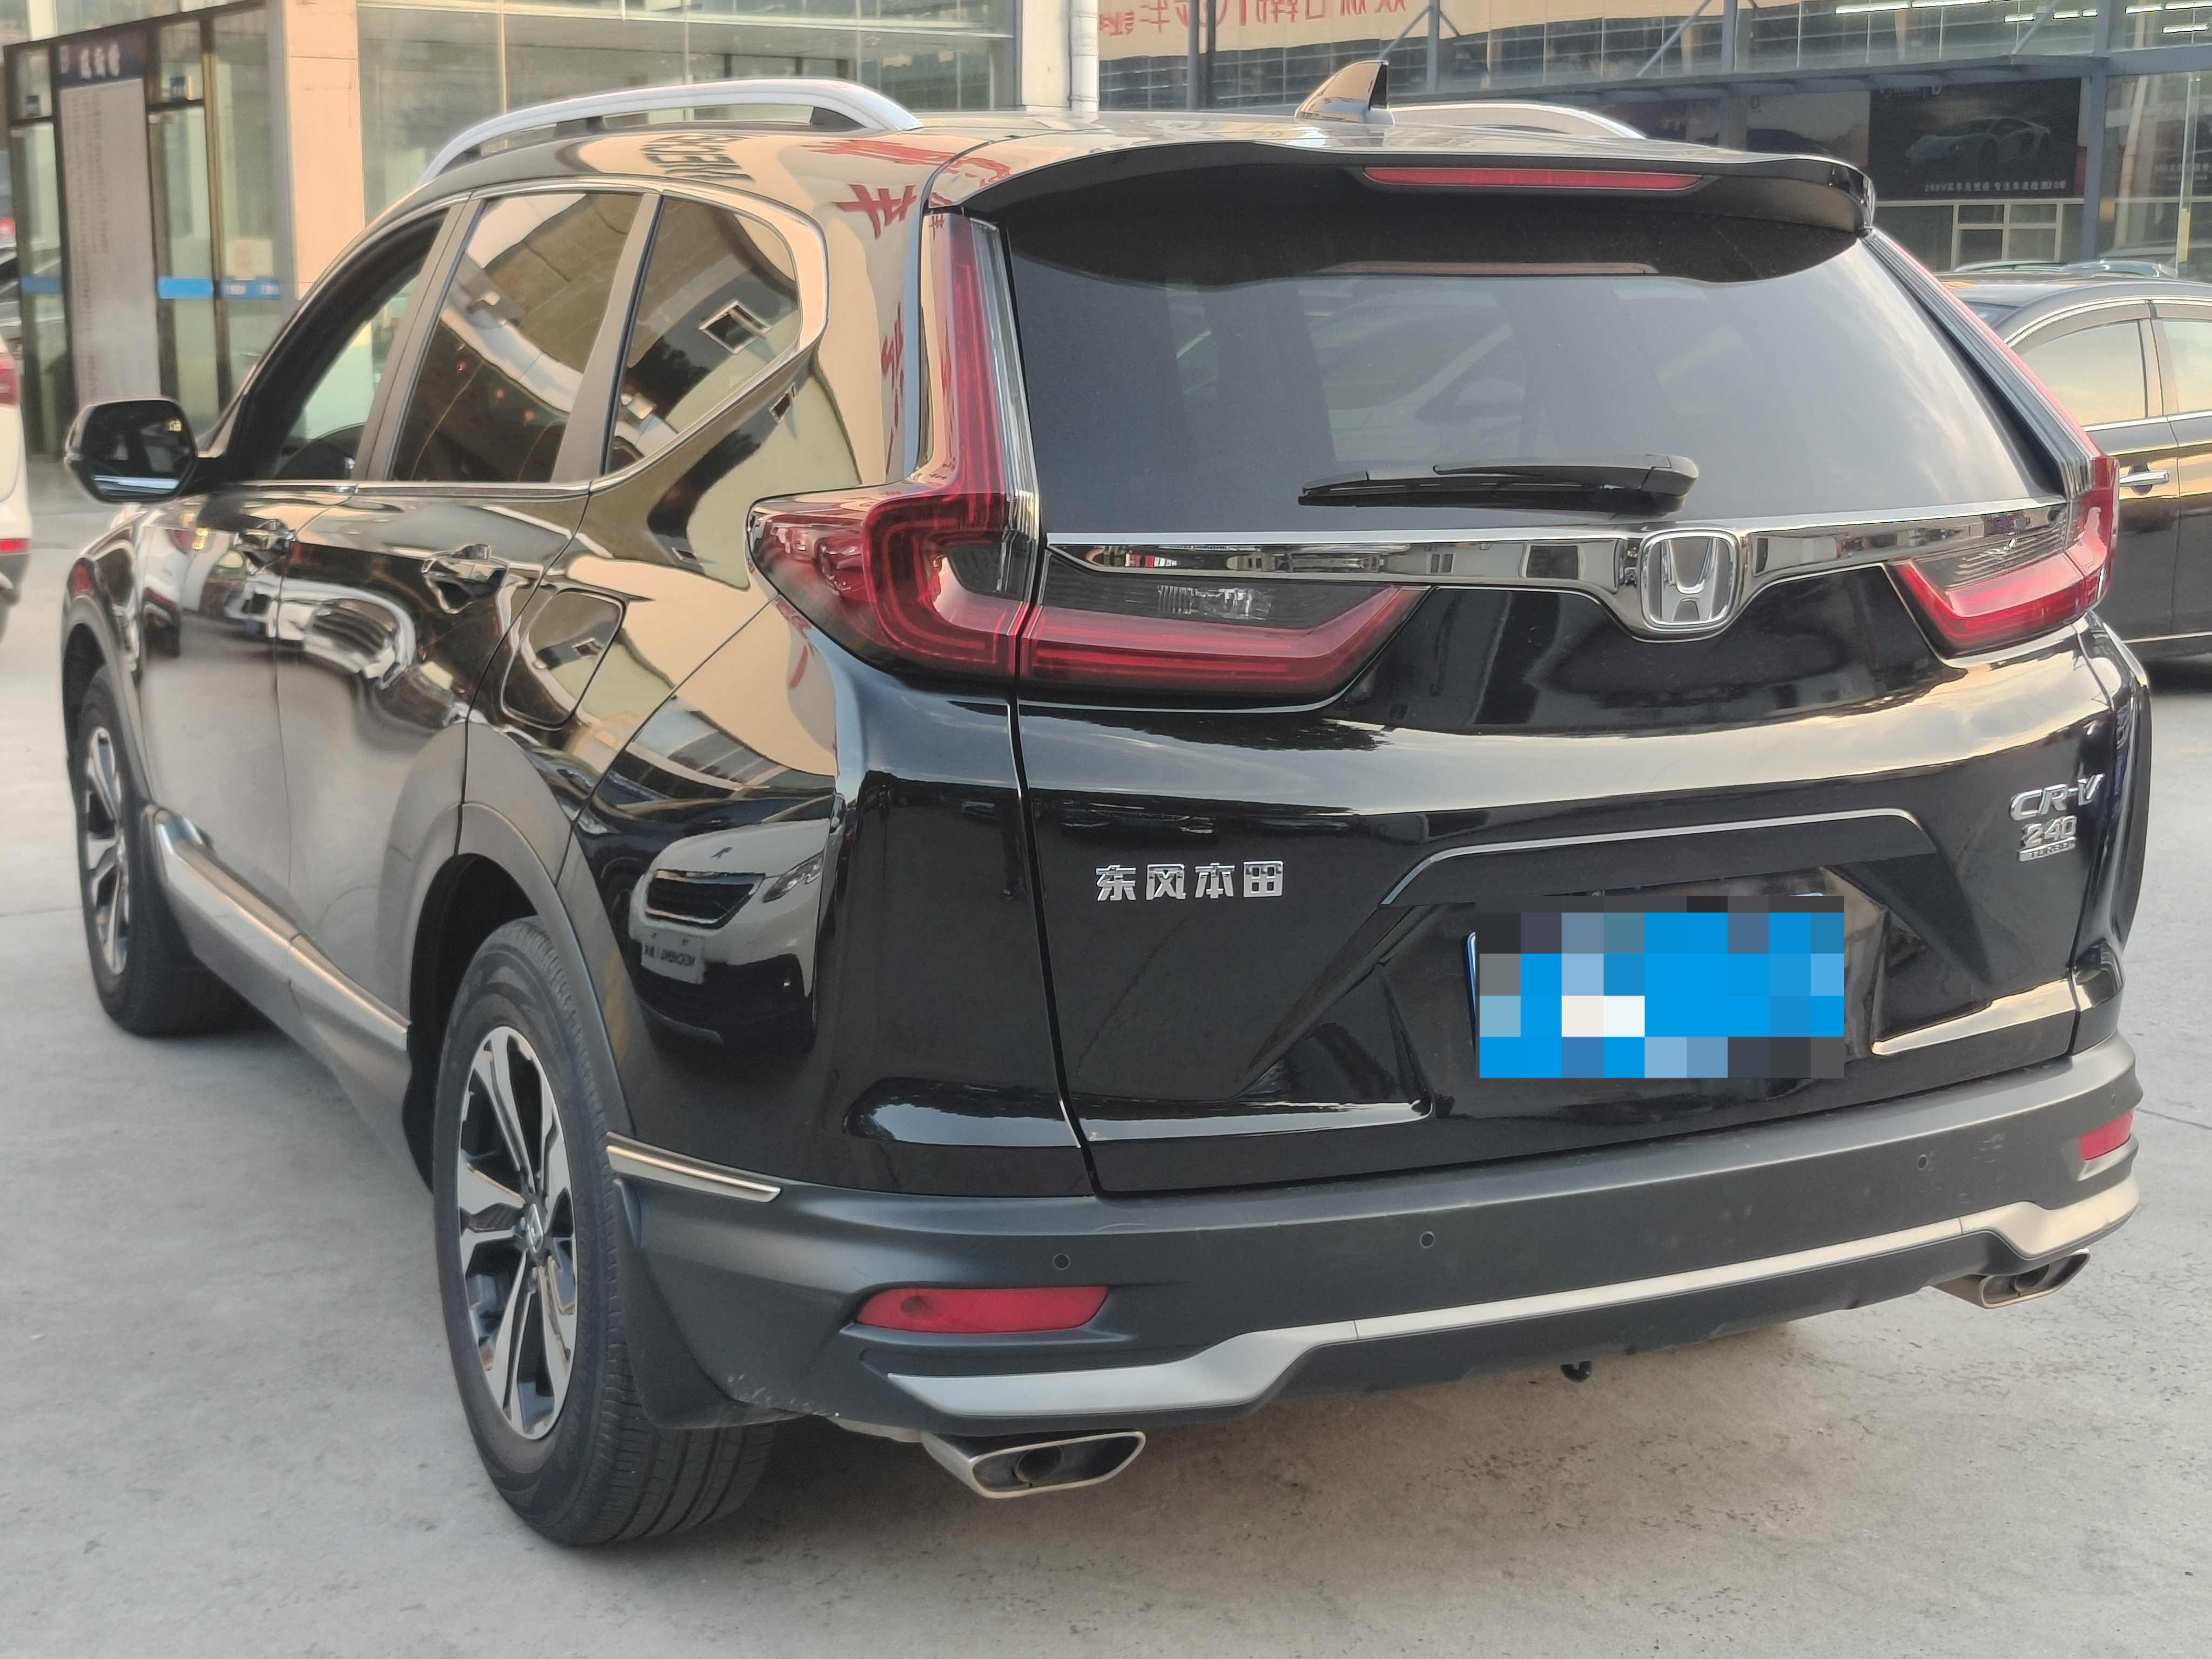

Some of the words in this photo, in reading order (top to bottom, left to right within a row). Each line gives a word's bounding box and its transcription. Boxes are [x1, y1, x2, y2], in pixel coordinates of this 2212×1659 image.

[2011, 774, 2105, 821] CR-V
[2022, 815, 2077, 848] 240
[1095, 860, 1284, 901] 东风本田
